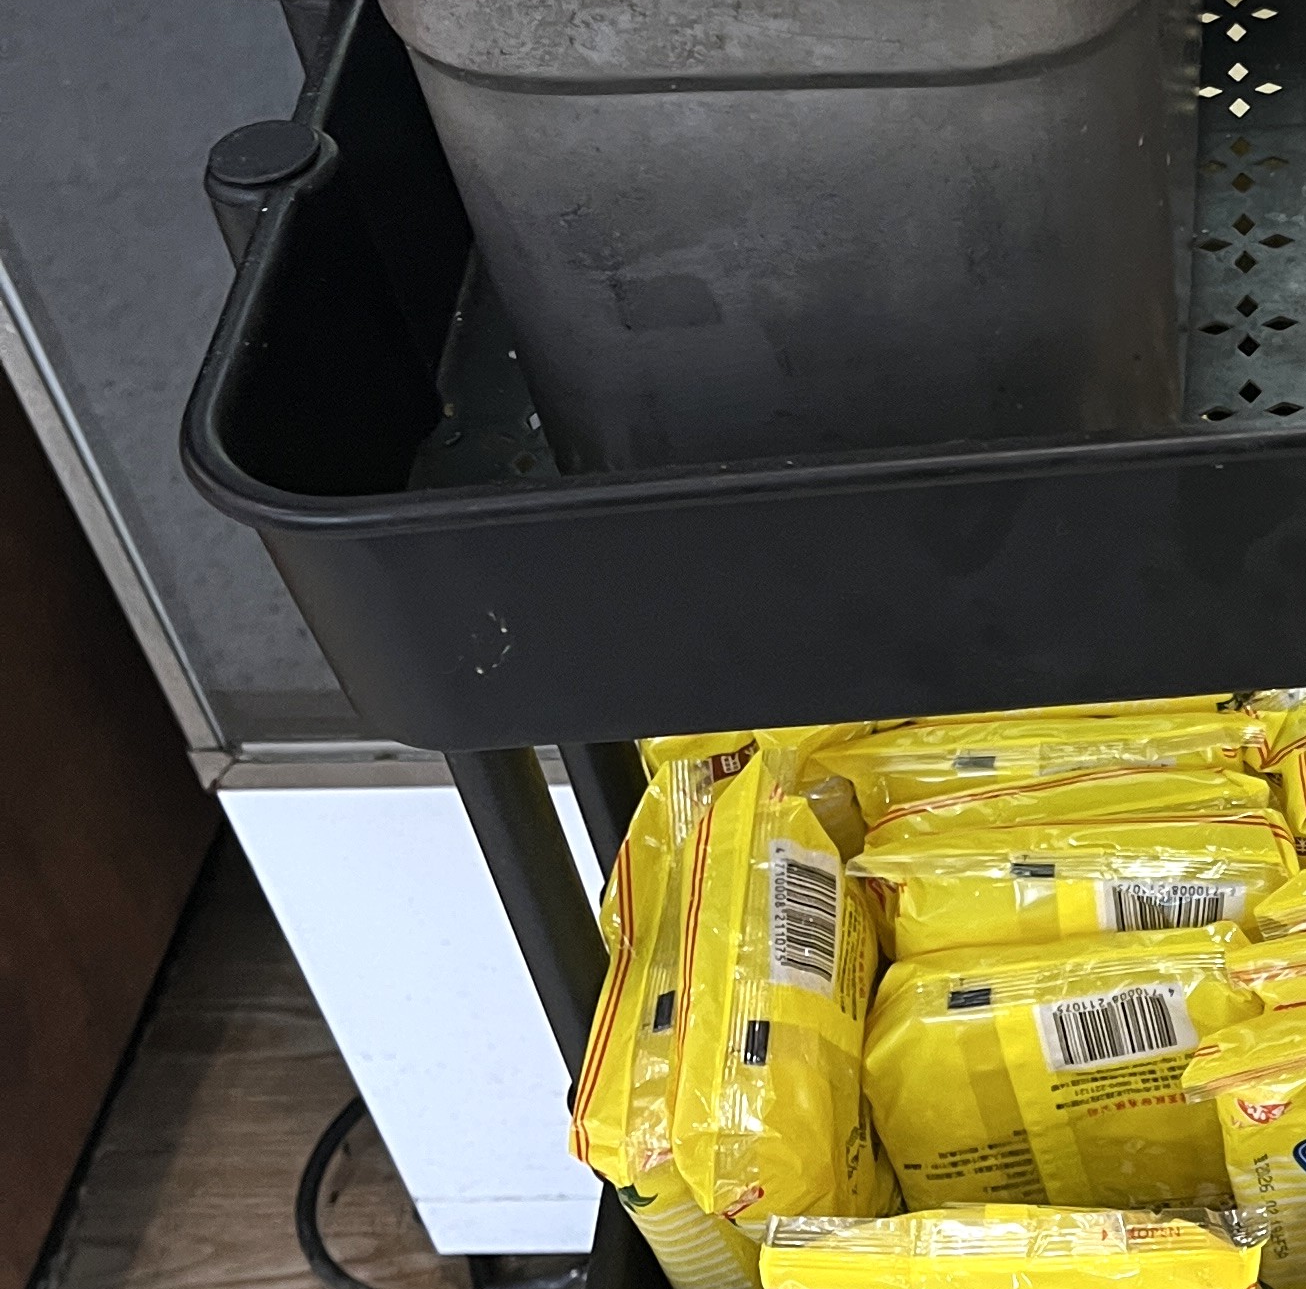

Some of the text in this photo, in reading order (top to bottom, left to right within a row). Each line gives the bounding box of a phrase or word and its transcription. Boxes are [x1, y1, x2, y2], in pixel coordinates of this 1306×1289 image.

[774, 864, 787, 909] 710008
[774, 914, 787, 962] 211075
[1057, 997, 1105, 1014] 211075
